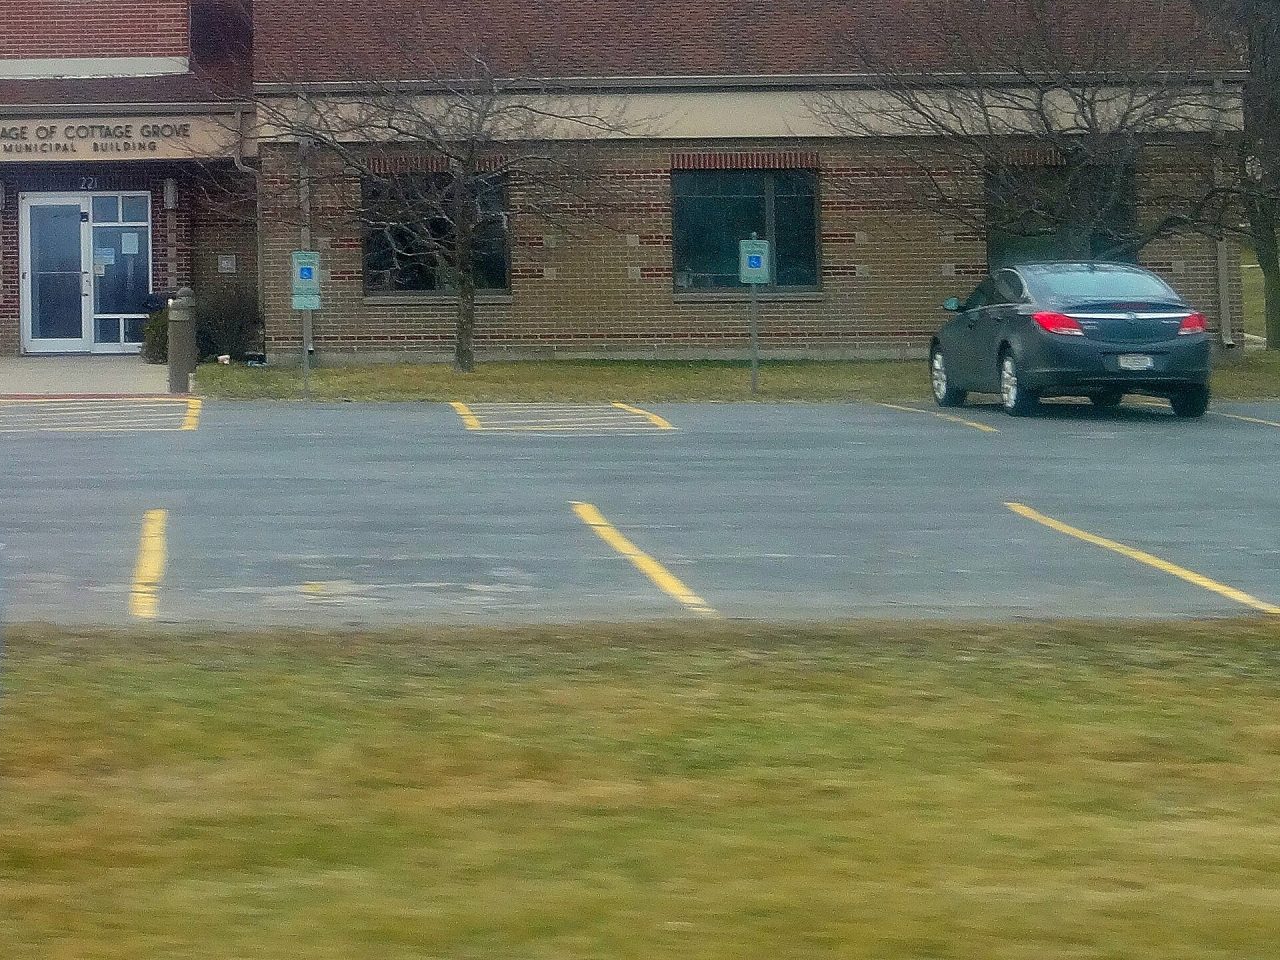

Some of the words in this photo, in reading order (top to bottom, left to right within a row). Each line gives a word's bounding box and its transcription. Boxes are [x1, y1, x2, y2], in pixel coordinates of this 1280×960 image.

[35, 124, 57, 139] OF
[64, 123, 133, 139] COTTAGE
[140, 122, 191, 139] GROVE
[3, 142, 77, 153] MUNICIPAL
[93, 141, 158, 152] BUILDING
